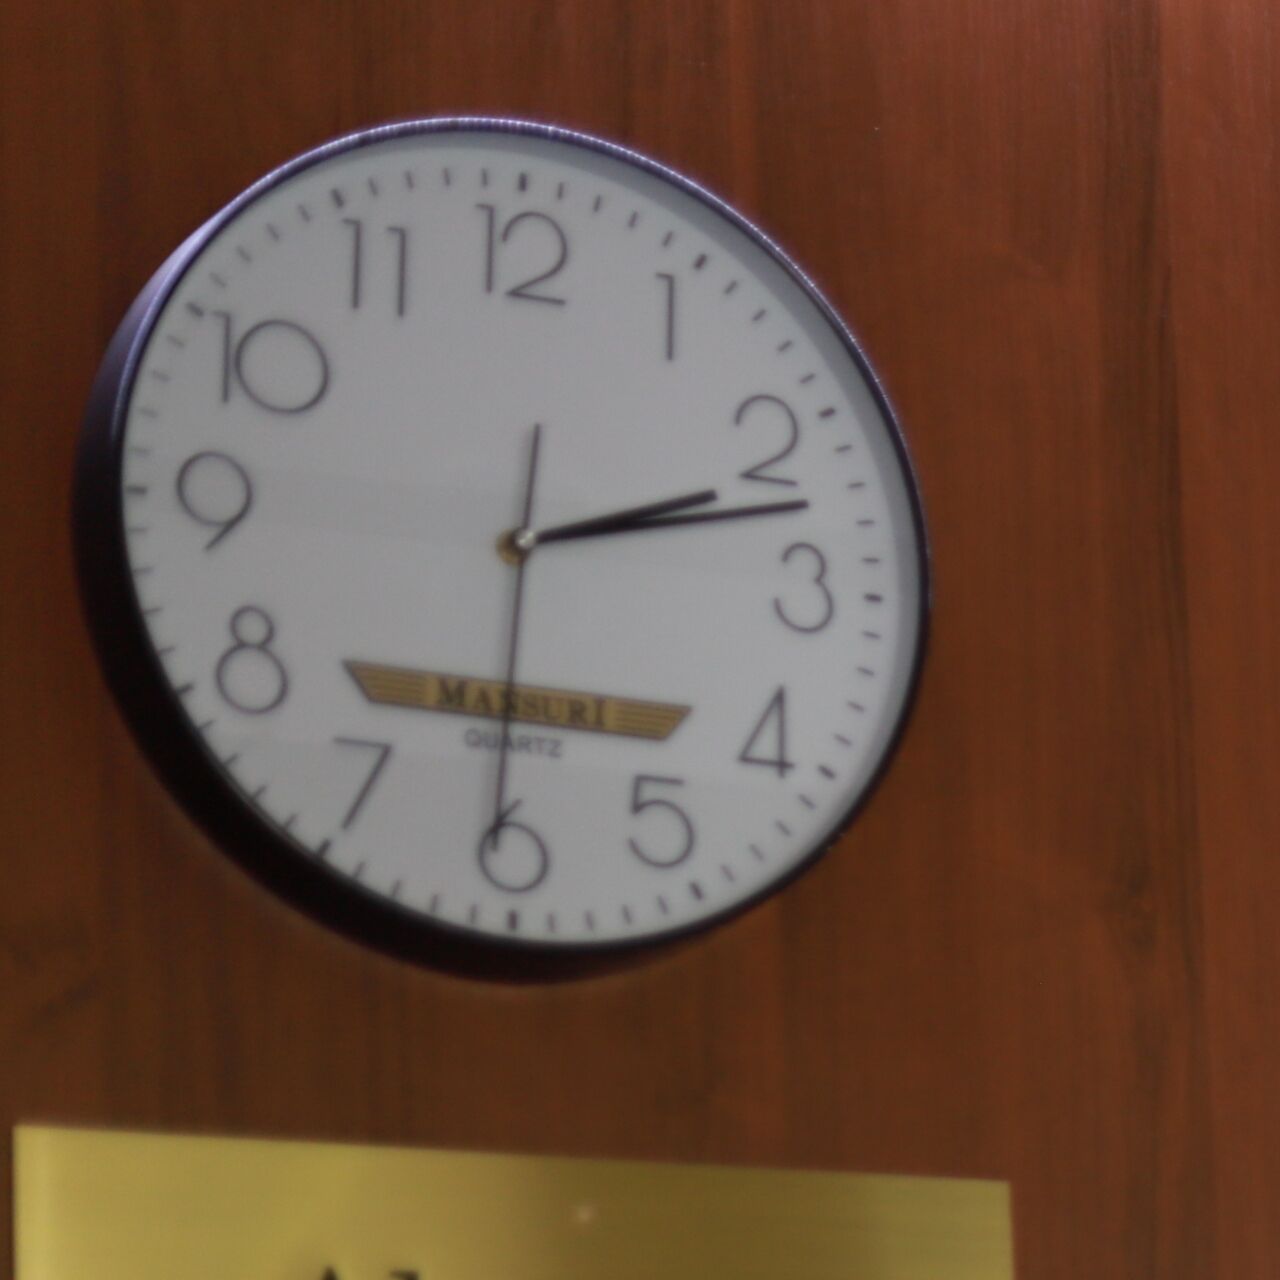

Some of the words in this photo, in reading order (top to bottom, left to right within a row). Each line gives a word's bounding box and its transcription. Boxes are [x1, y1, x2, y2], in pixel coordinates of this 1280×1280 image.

[342, 218, 406, 318] 11
[476, 202, 568, 306] 12
[212, 310, 331, 417] 10
[655, 272, 675, 362] 1
[733, 393, 799, 487] 2
[175, 450, 253, 552] 9
[773, 541, 836, 634] 3
[214, 604, 290, 715] 8
[737, 684, 796, 780] 4
[331, 735, 392, 831] 7
[627, 773, 697, 869] 5
[477, 798, 551, 894] 6
